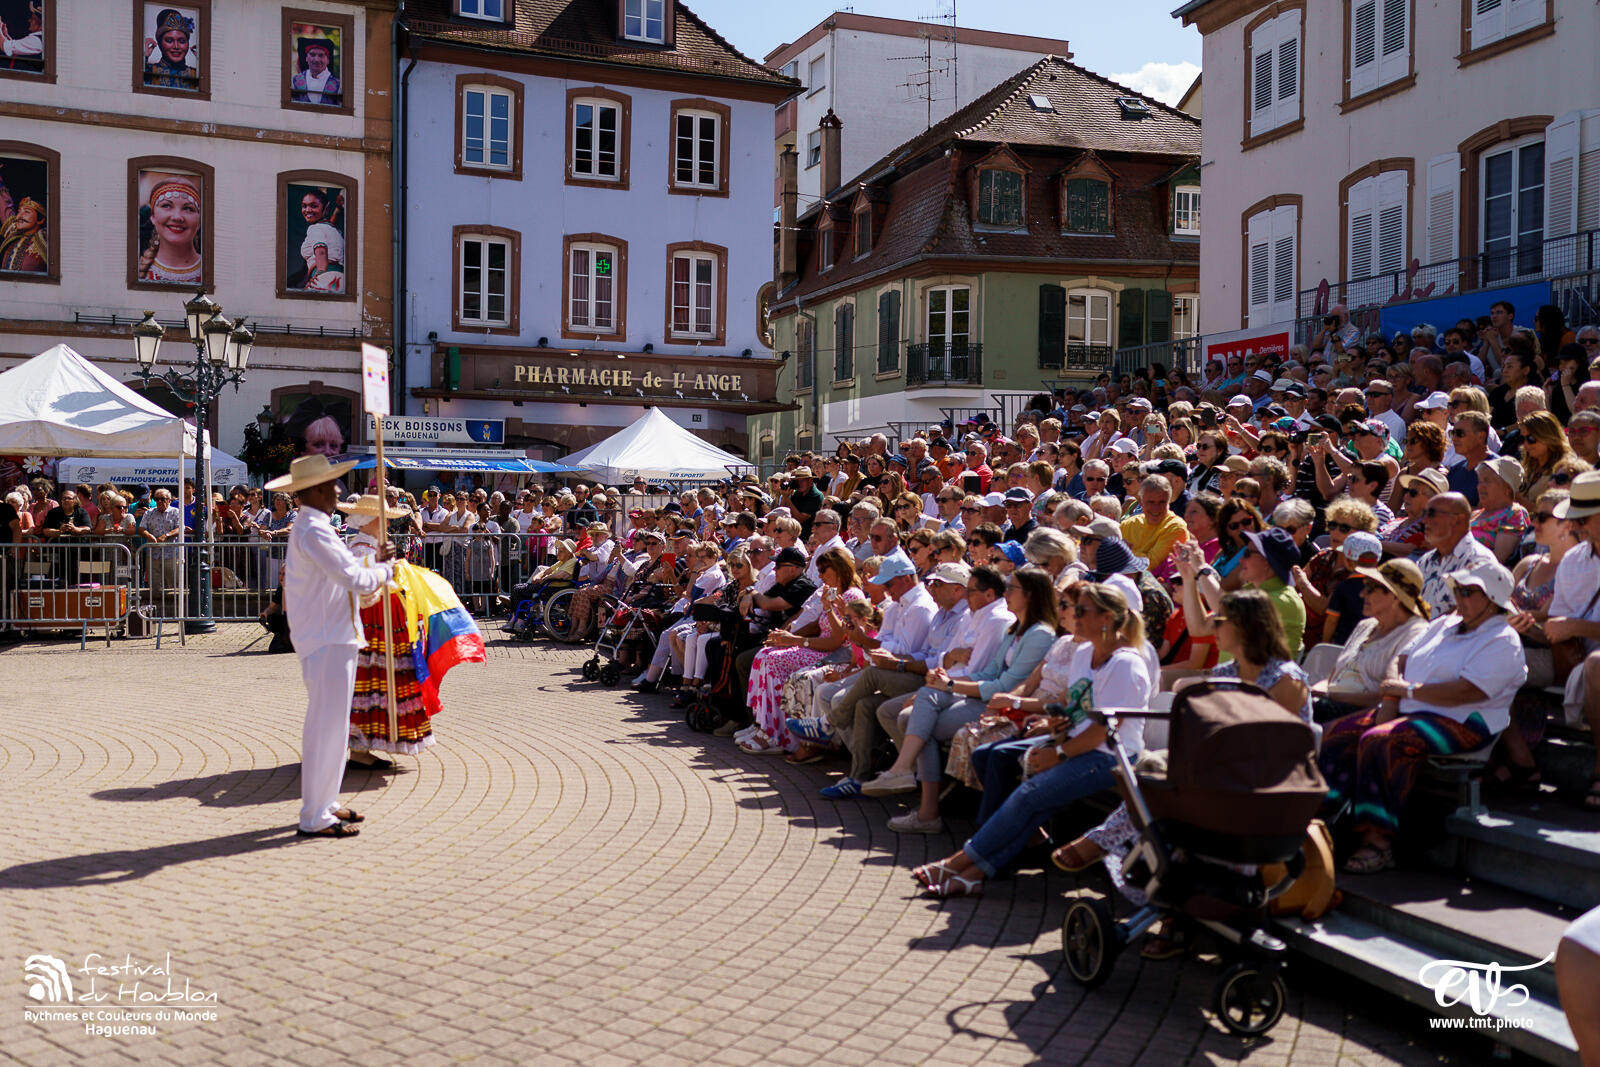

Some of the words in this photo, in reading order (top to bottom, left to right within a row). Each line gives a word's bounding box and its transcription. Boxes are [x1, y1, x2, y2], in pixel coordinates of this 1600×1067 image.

[513, 365, 632, 387] PHARMACIE
[642, 371, 662, 388] de
[672, 372, 686, 389] L'
[694, 374, 742, 391] ANGE
[405, 421, 463, 432] BOISSONS
[394, 431, 439, 440] HAGUENAU
[110, 476, 195, 484] HARTHOUSE-HAGU
